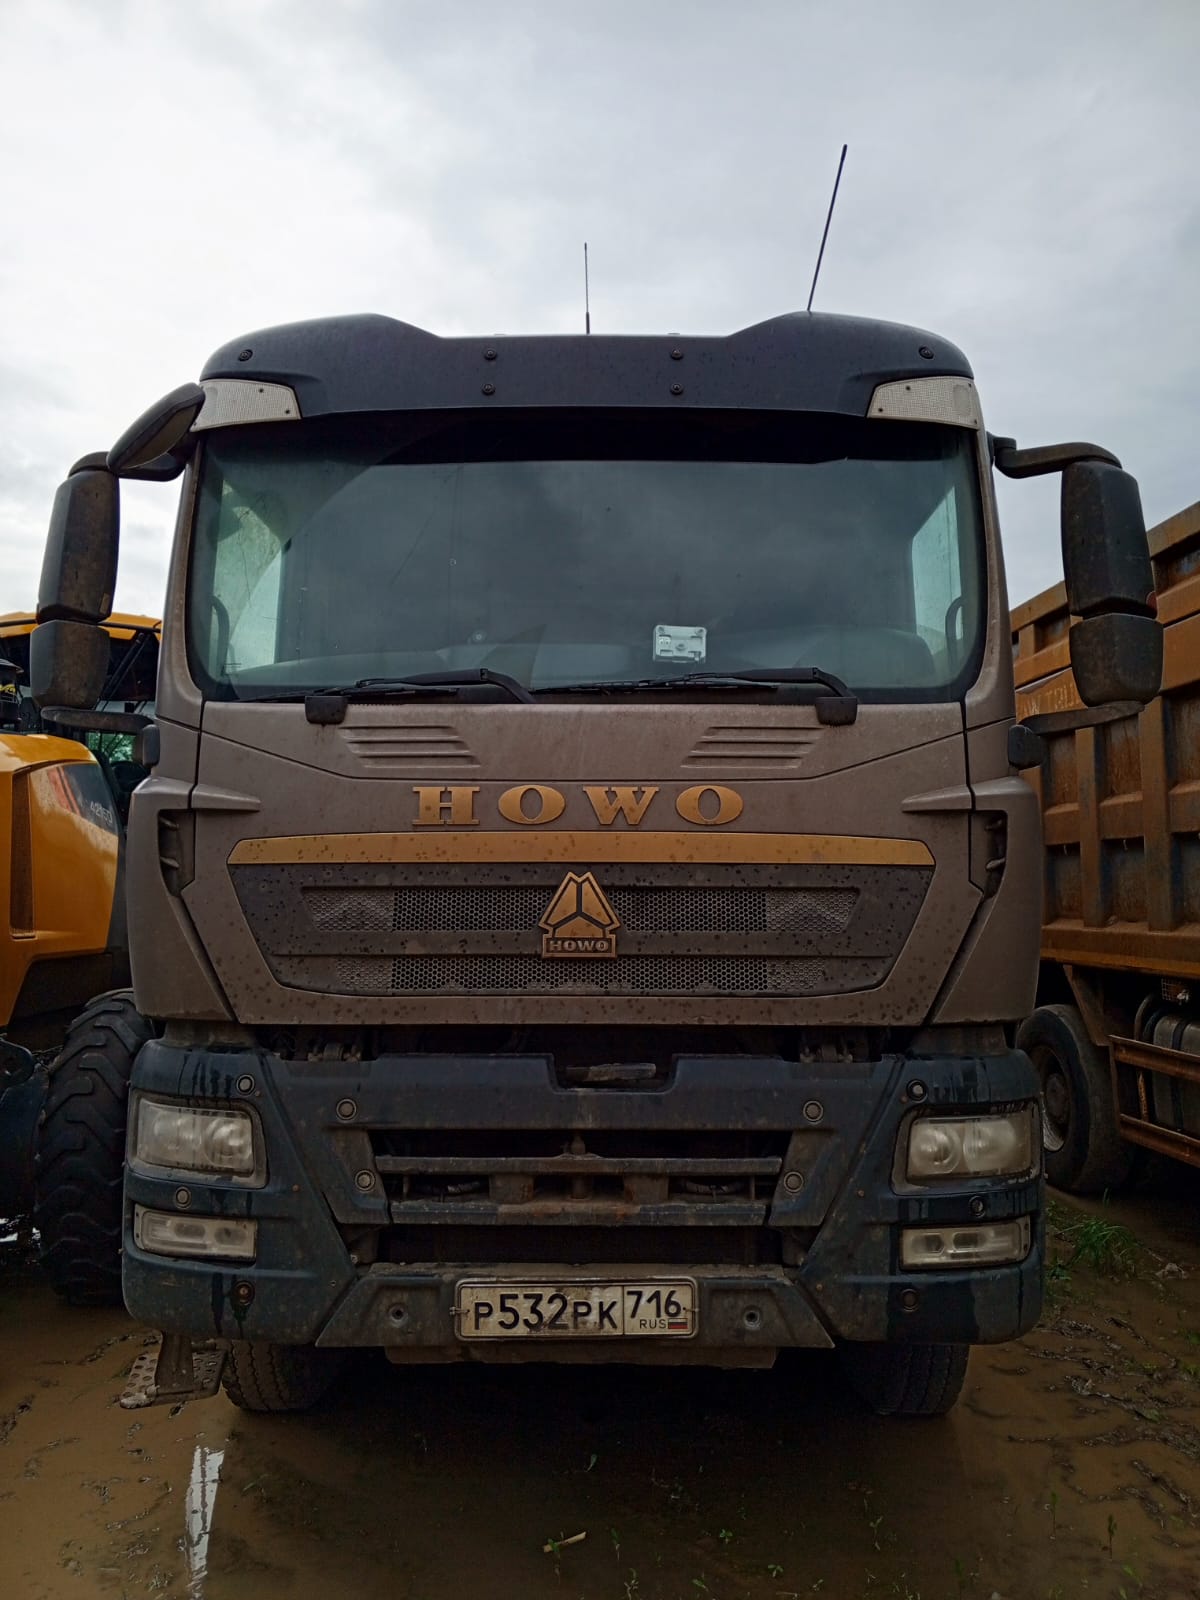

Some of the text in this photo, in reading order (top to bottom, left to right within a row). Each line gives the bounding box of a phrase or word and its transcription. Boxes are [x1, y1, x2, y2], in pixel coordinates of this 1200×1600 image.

[412, 785, 744, 825] HOWO
[549, 940, 609, 952] HOWO
[474, 1290, 682, 1330] P532PK 716
[639, 1319, 667, 1330] RUS
